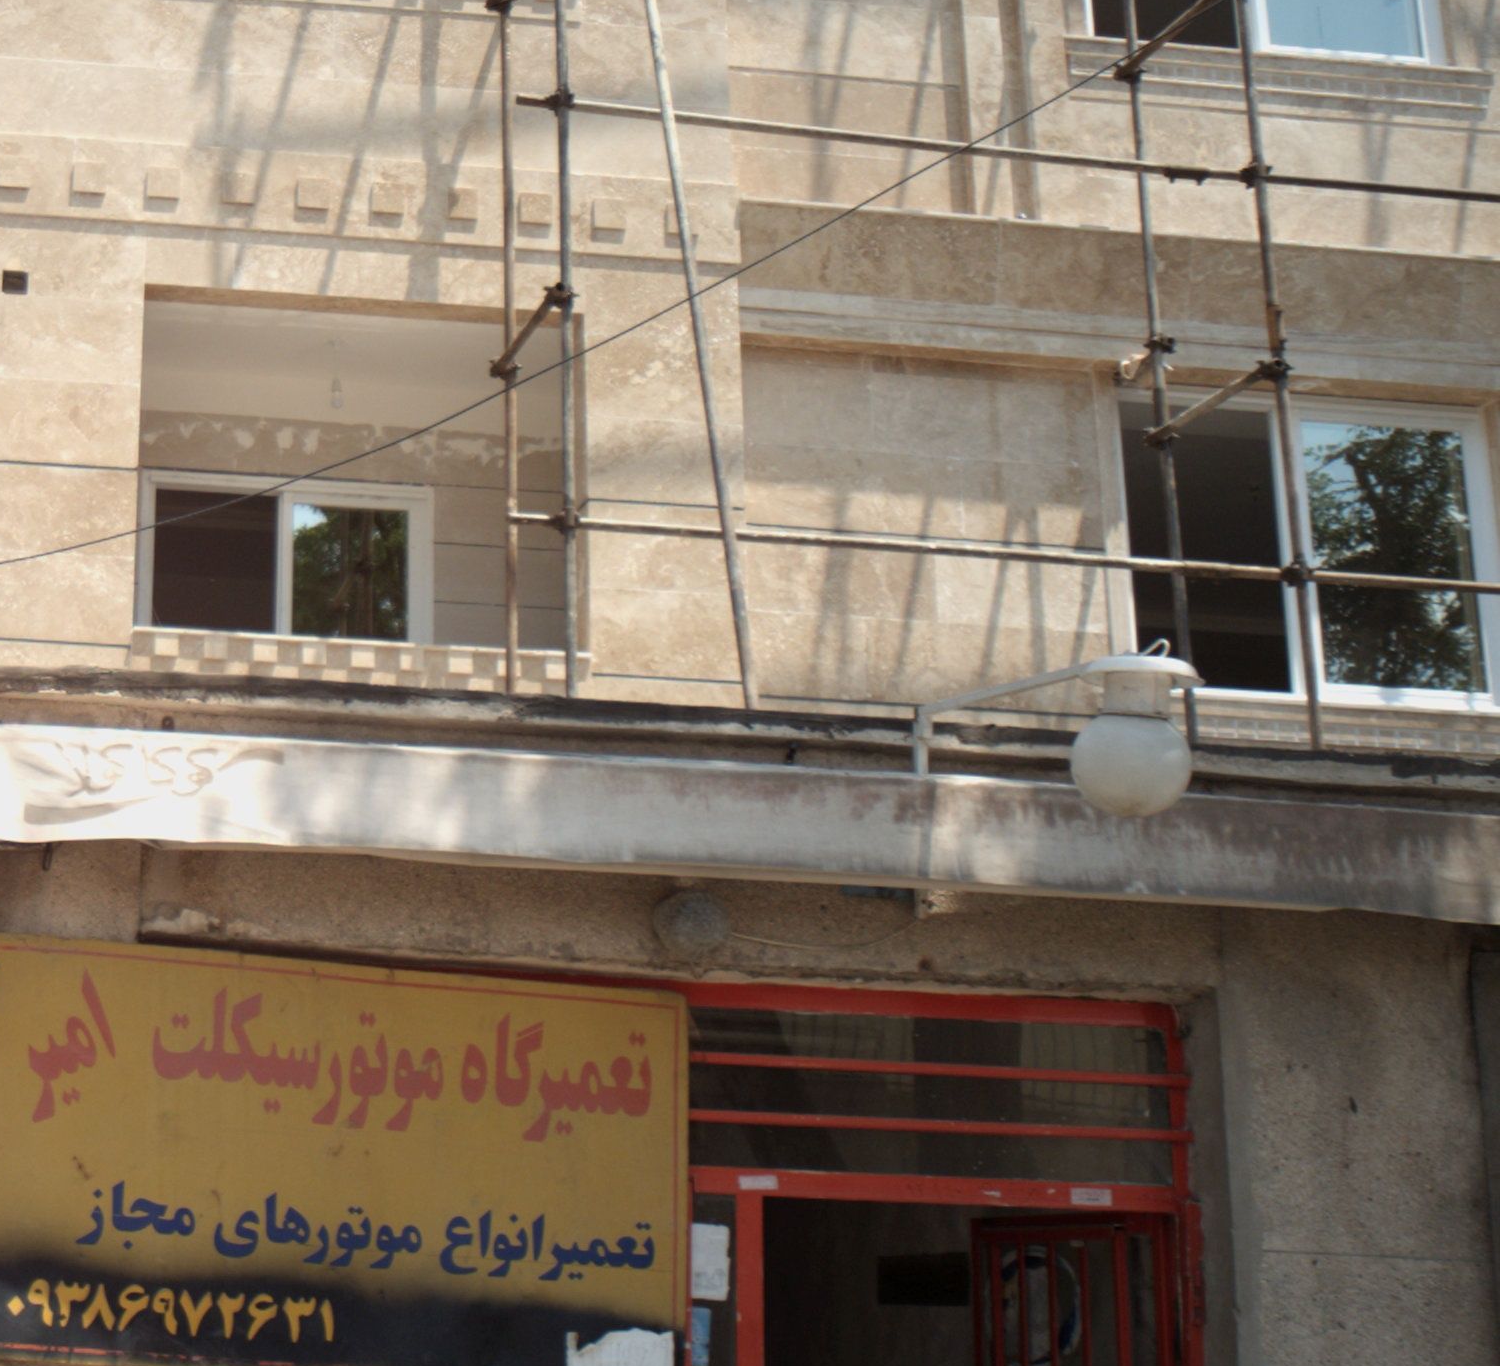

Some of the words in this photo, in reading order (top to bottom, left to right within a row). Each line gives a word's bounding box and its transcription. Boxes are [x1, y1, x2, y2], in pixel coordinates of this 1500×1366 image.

[28, 965, 116, 1123] امیر
[461, 1012, 651, 1142] تعمیرگاه
[75, 1180, 196, 1250] مجاز
[213, 1192, 421, 1269] موتورهای
[6, 1278, 335, 1343] ۰۹۳۸۶۹۷۲۶۳۱
